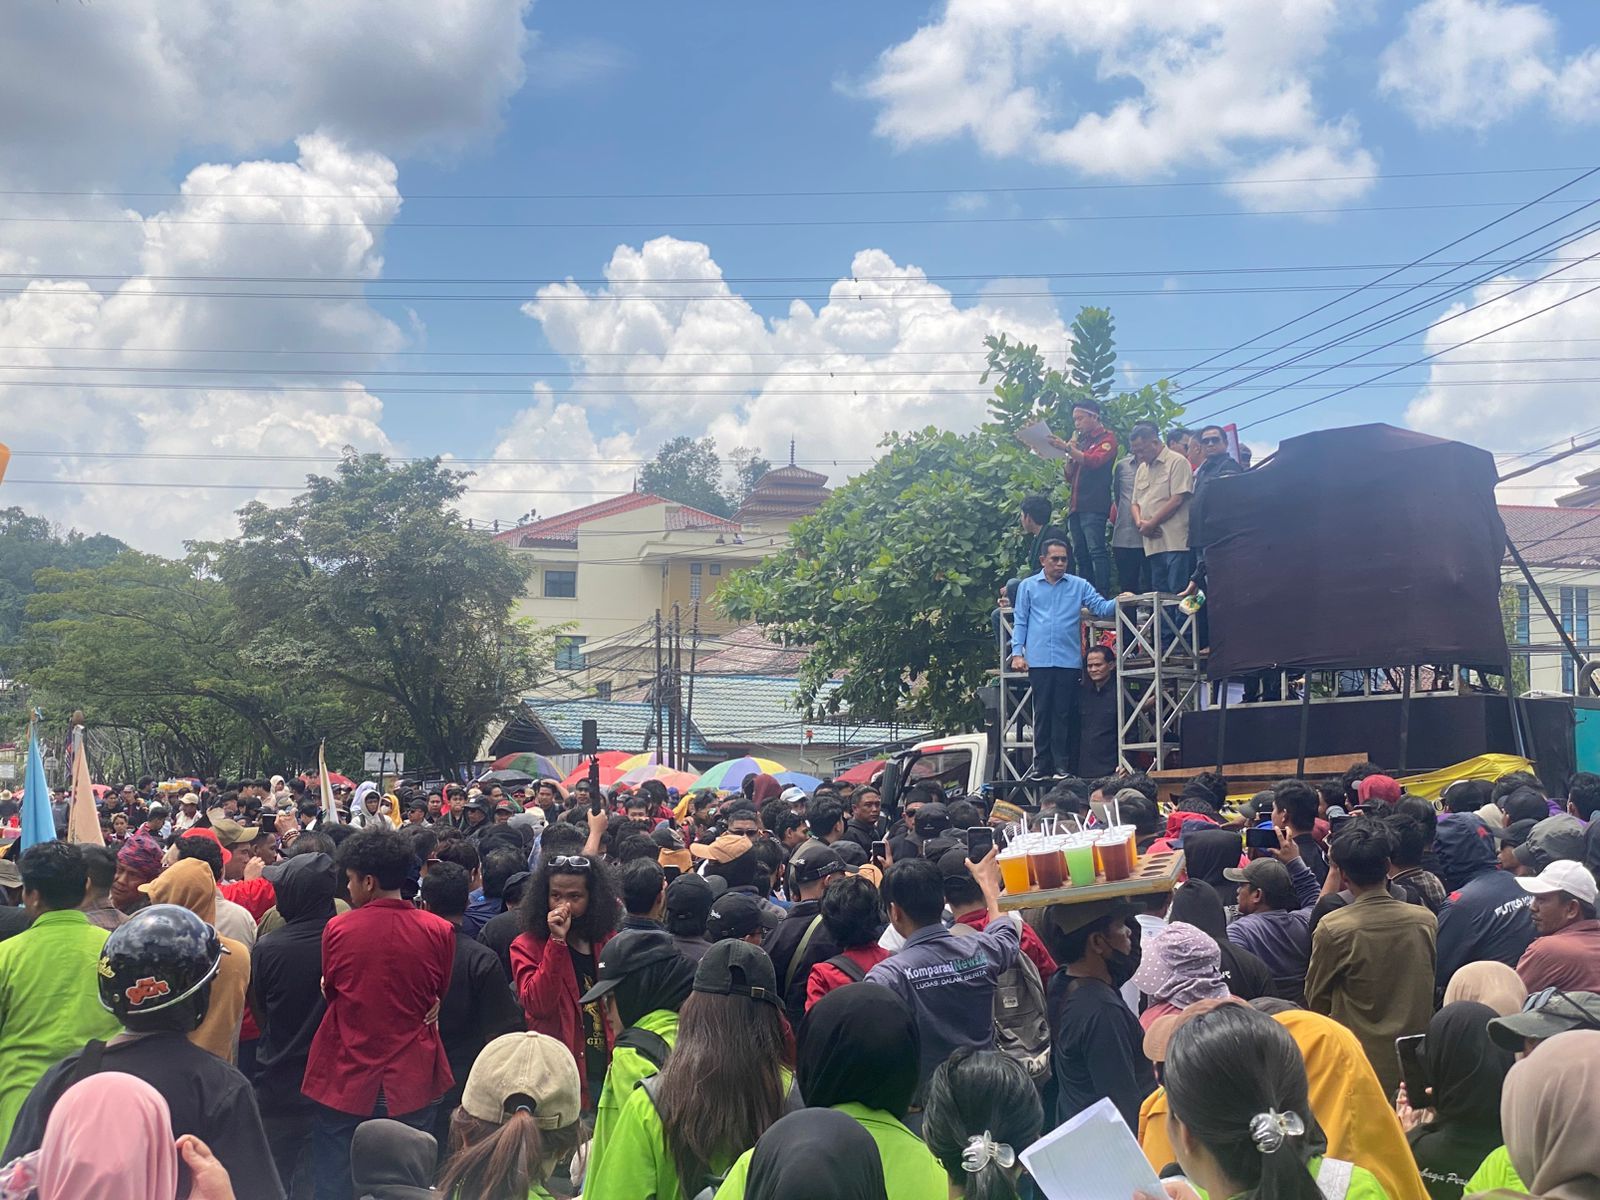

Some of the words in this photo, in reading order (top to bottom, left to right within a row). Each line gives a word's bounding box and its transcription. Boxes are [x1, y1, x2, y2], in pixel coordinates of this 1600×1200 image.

[915, 980, 939, 990] LUGAS
[941, 975, 963, 986] DALAM
[963, 969, 987, 981] BERITA
[1419, 1167, 1445, 1183] baga
